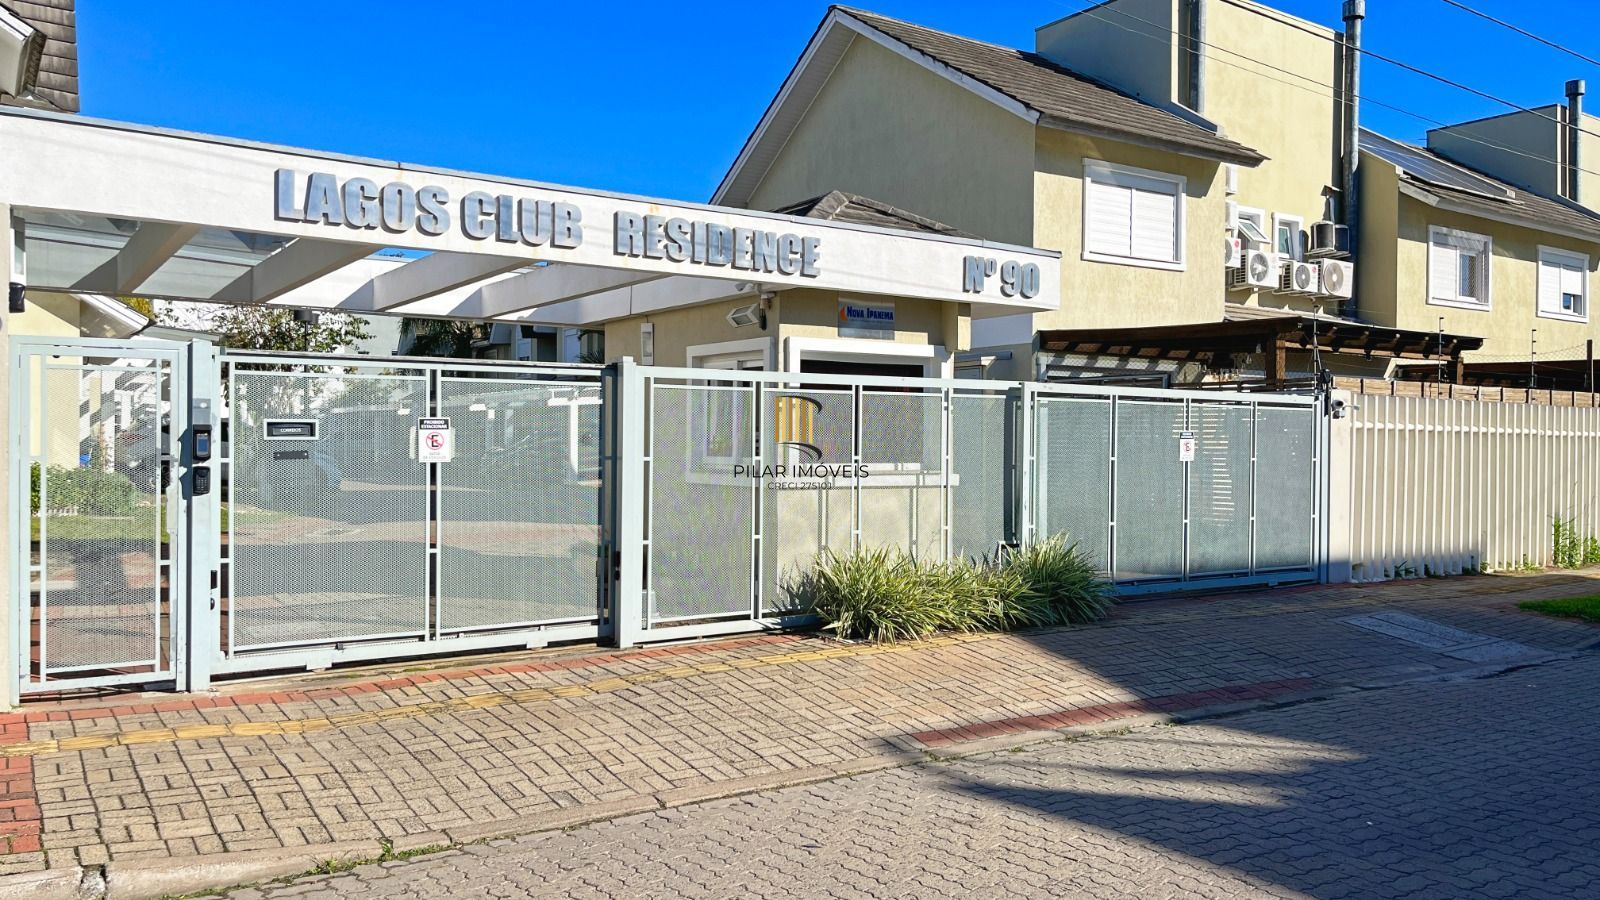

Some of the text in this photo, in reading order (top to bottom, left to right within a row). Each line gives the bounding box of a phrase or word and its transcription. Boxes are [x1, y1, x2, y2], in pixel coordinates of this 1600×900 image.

[274, 168, 451, 237] LAGOS
[460, 190, 583, 249] CLUB
[613, 210, 821, 278] RESIDENCE
[1000, 259, 1040, 299] 90
